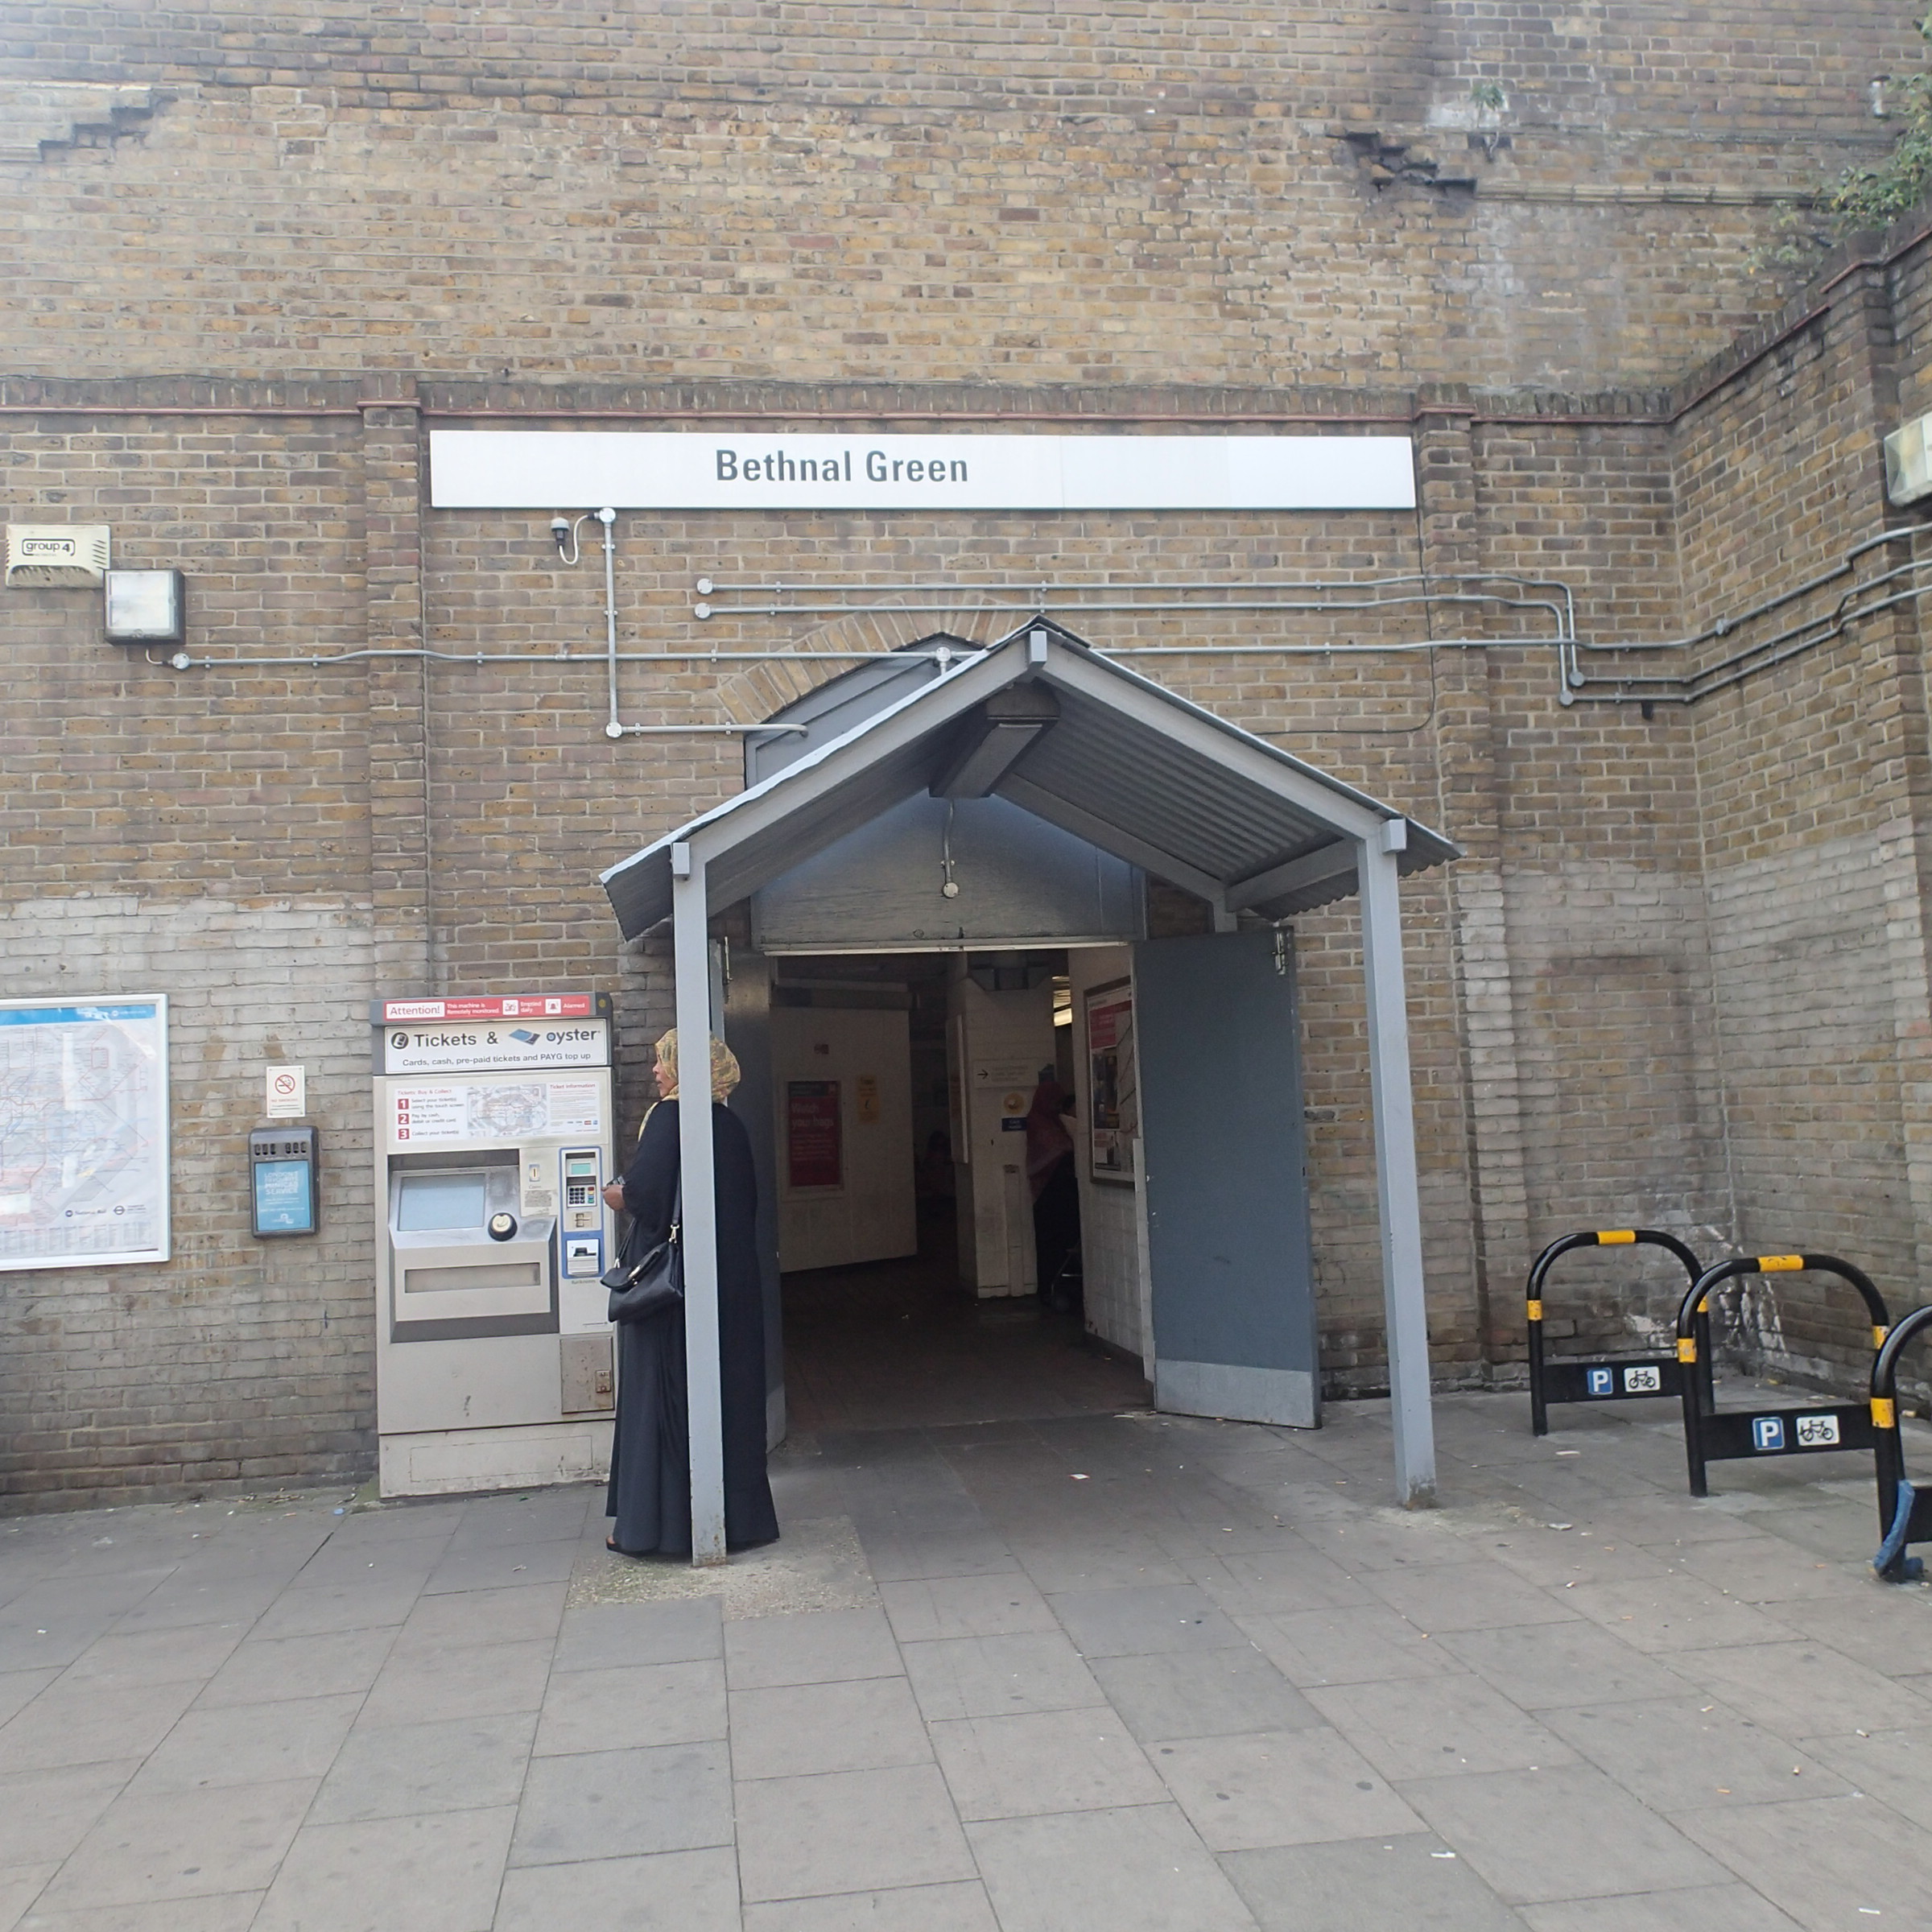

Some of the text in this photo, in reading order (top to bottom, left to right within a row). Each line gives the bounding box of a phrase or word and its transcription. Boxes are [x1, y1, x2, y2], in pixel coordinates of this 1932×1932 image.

[716, 449, 968, 482] Bethnal Green
[26, 543, 70, 552] group 4
[390, 1005, 440, 1015] Attention!
[414, 1029, 597, 1047] Tickets & oyster
[402, 1059, 430, 1067] Cards,
[431, 1057, 454, 1065] cash,
[456, 1055, 491, 1065] pre-paid
[540, 1053, 563, 1061] PAYG
[565, 1053, 578, 1061] top
[792, 1116, 834, 1130] your bags
[1592, 1370, 1608, 1393] P
[1760, 1421, 1780, 1447] P
